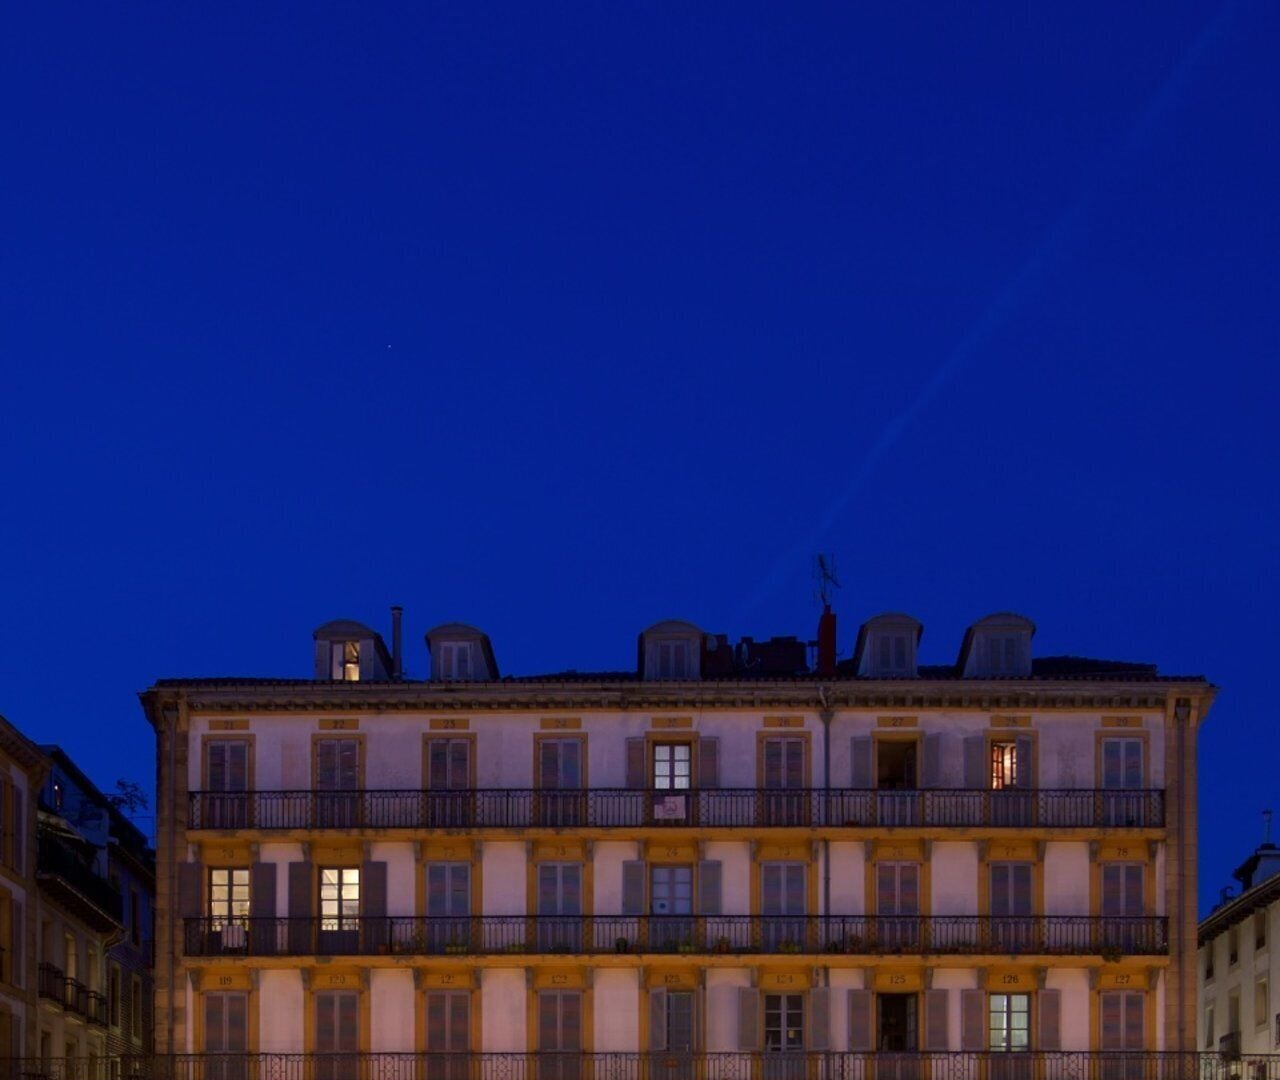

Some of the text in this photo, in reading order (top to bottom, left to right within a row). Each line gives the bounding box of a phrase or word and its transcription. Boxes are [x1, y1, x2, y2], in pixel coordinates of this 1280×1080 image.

[333, 720, 344, 729] 22
[443, 720, 455, 729] 23
[892, 717, 904, 726] 27
[1117, 848, 1128, 857] 78
[891, 975, 905, 984] 125
[1116, 975, 1130, 984] 127
